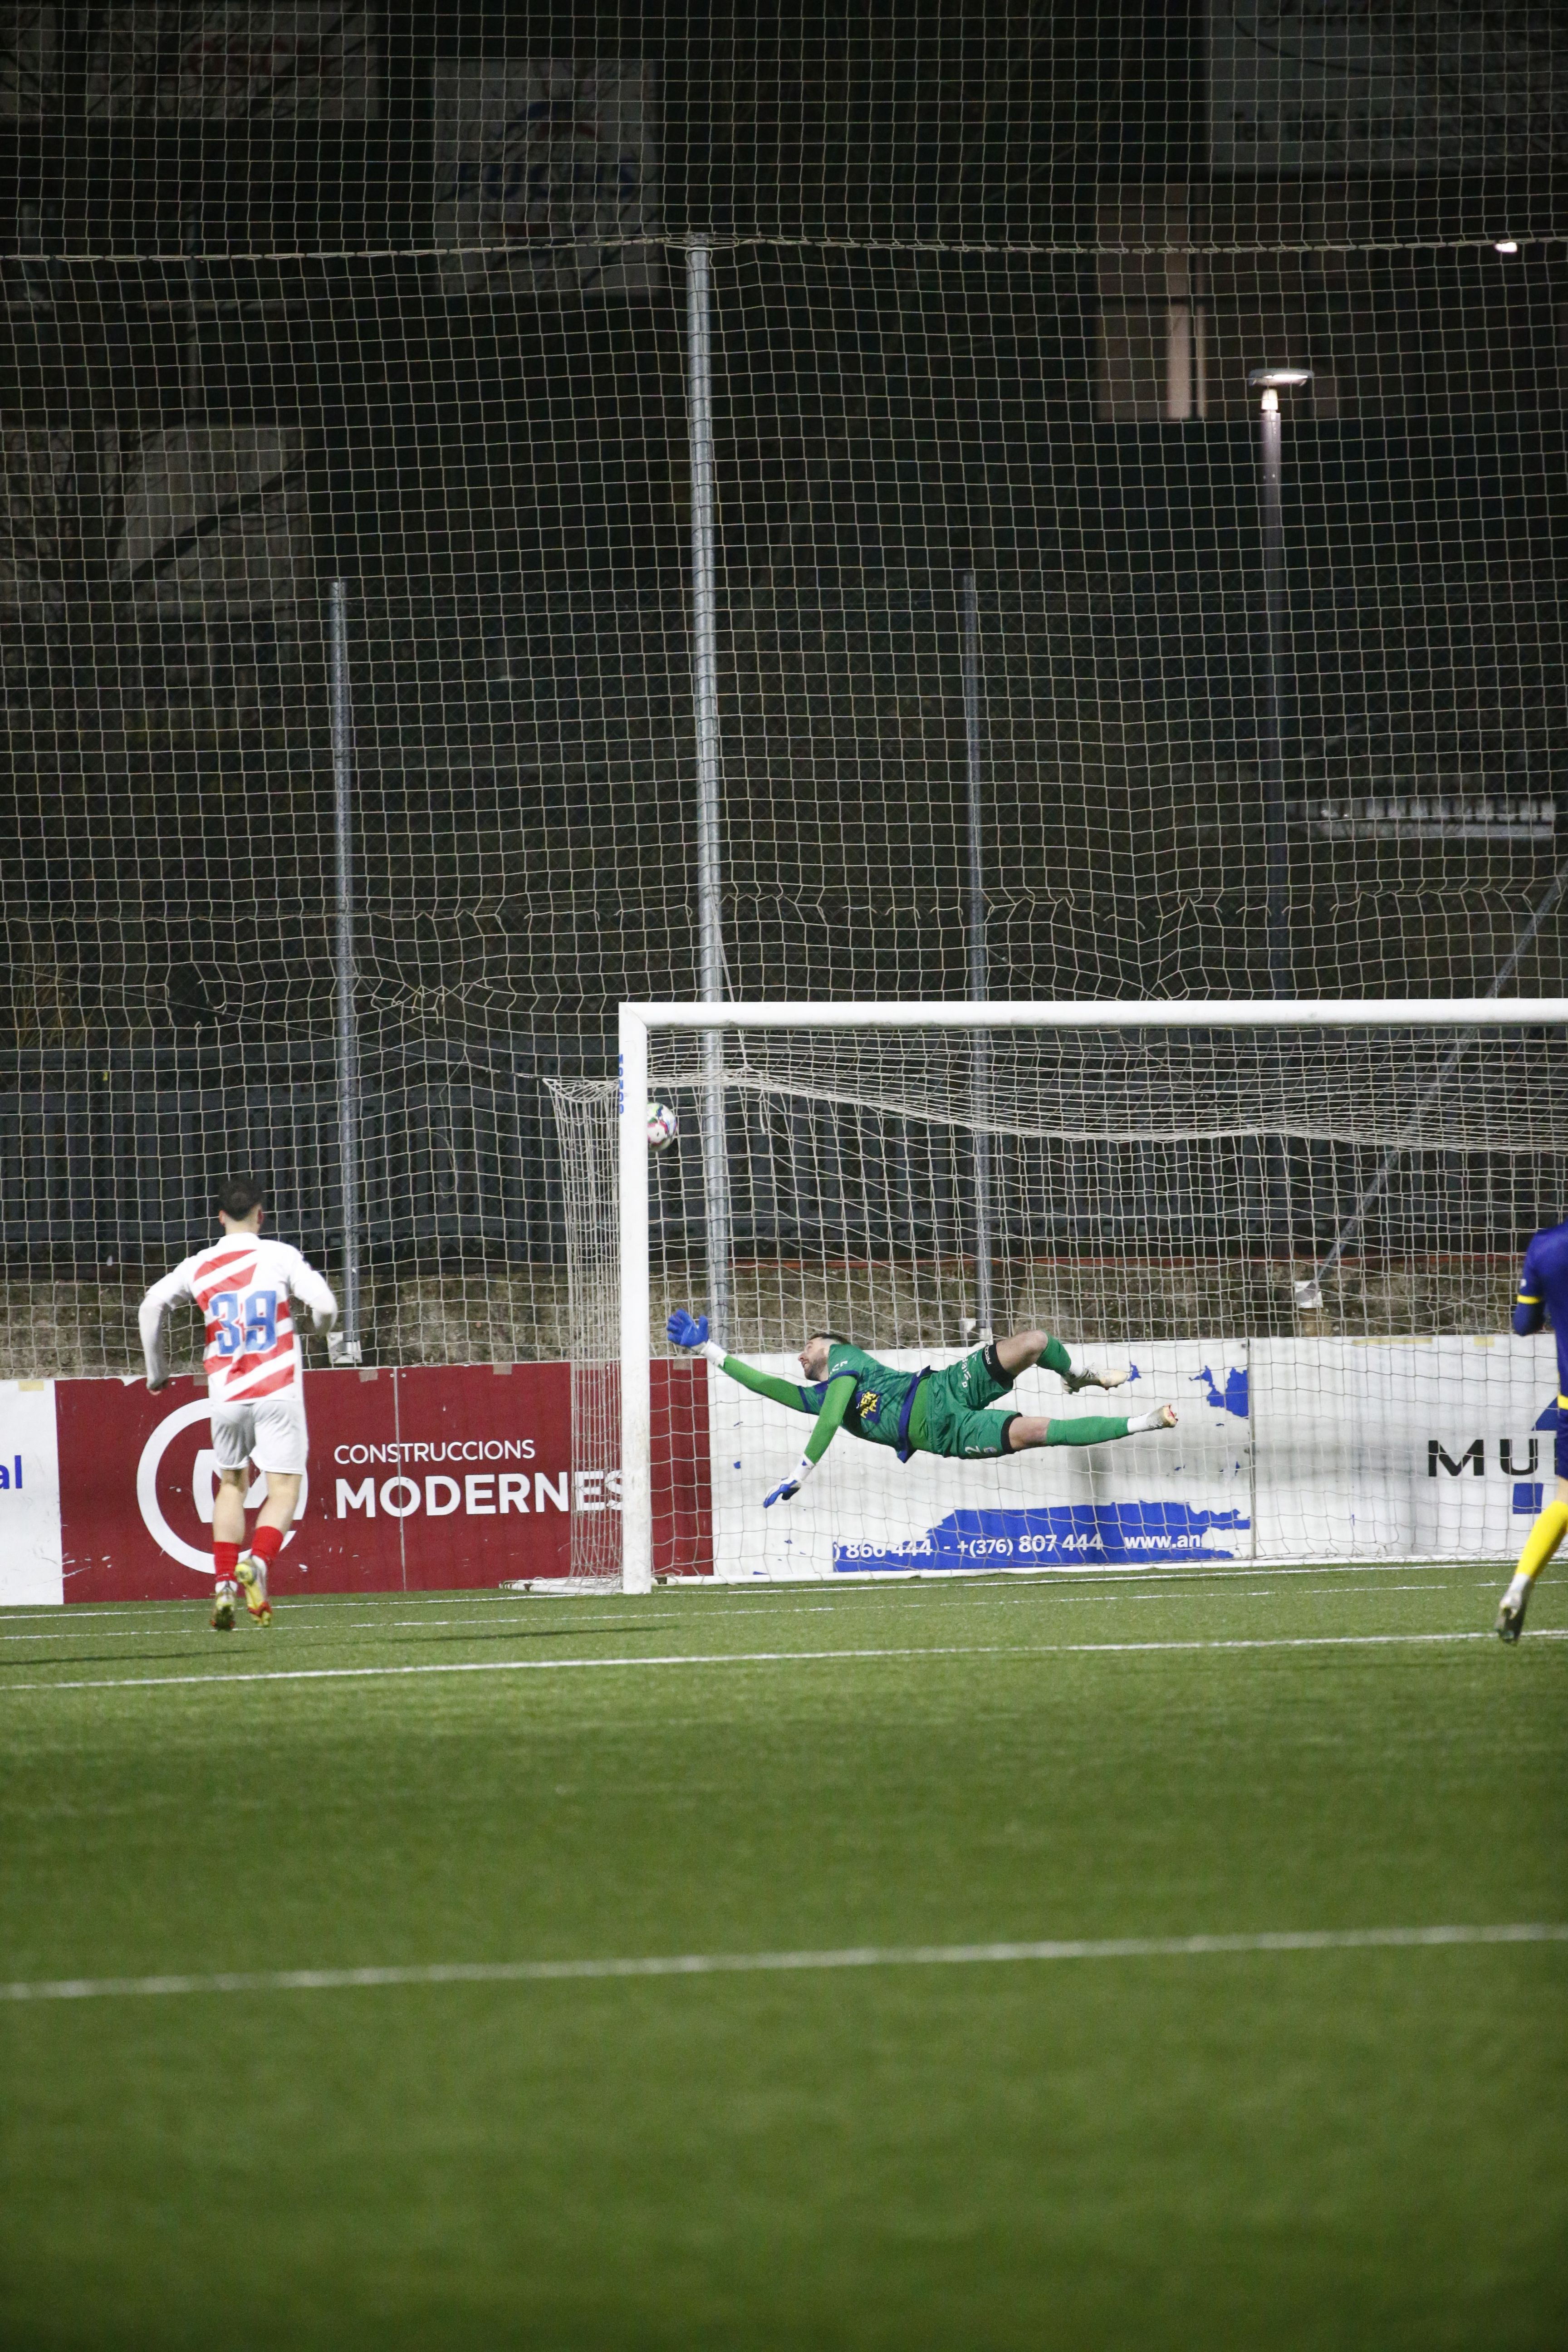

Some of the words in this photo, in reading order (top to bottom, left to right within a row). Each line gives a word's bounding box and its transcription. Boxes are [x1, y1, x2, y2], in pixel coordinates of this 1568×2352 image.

[209, 1290, 277, 1355] 39
[334, 1439, 535, 1464] CONSTRUCCIONS
[1428, 1438, 1558, 1477] MU
[336, 1470, 622, 1519] MODERNES
[957, 1539, 1013, 1558] +(376)
[1018, 1534, 1057, 1553] 807
[1062, 1534, 1103, 1551] 444
